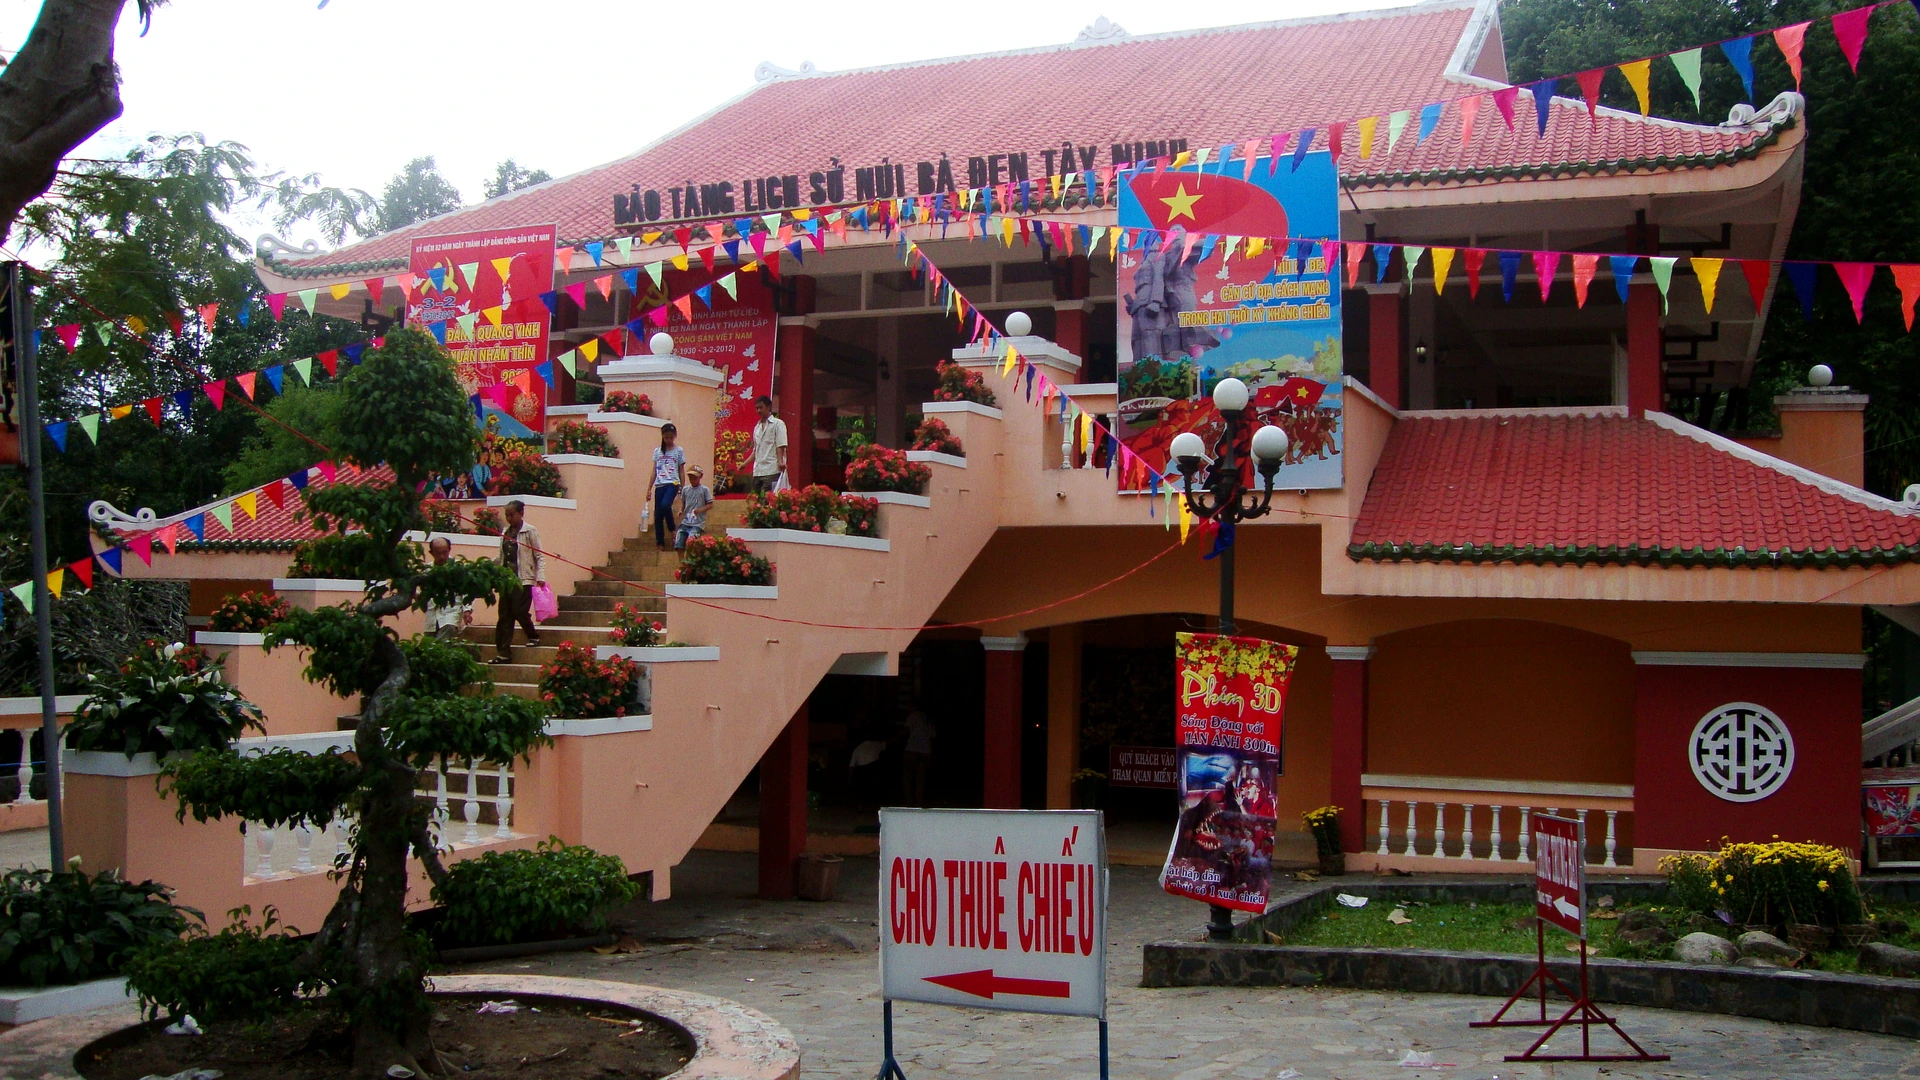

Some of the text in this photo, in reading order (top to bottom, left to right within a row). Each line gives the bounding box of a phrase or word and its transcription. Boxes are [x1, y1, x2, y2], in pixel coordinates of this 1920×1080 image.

[614, 183, 661, 224] BẢO
[668, 180, 735, 219] TÀNG
[809, 157, 845, 205] SỬ
[855, 157, 906, 201] NÚI
[917, 152, 956, 196] BÀ
[967, 152, 1030, 190] ĐEN
[1040, 141, 1098, 184] TÂY
[504, 235, 516, 245] CỘNG
[528, 232, 538, 243] VIỆT
[539, 233, 550, 242] NAM
[1220, 279, 1330, 302] CĂN CỨ ĐỊA CÁCH MẠNG
[422, 295, 456, 309] 3-2
[1178, 310, 1210, 327] TRONG
[1210, 308, 1228, 326] HAI
[1228, 304, 1251, 324] THỜI
[1267, 301, 1300, 321] KHÁNG
[1300, 298, 1331, 319] CHIẾN
[477, 324, 513, 343] QUANG
[514, 322, 540, 340] VINH
[735, 331, 752, 340] NAM
[478, 344, 510, 362] NHÂM
[1181, 669, 1282, 718] Phim 3D
[1181, 713, 1265, 735] Sống Động với
[1211, 728, 1241, 749] ẢNH
[1119, 750, 1175, 767] QUÝ KHÁCH VÀO
[1112, 768, 1131, 781] THAM
[1133, 769, 1151, 783] QUAN
[1181, 865, 1200, 881] hấp
[1202, 867, 1221, 882] dẫn
[890, 825, 1094, 957] CHO THUÊ CHIẾU
[1195, 883, 1207, 896] có
[1210, 885, 1216, 898] 1
[1239, 890, 1265, 905] chiếu
